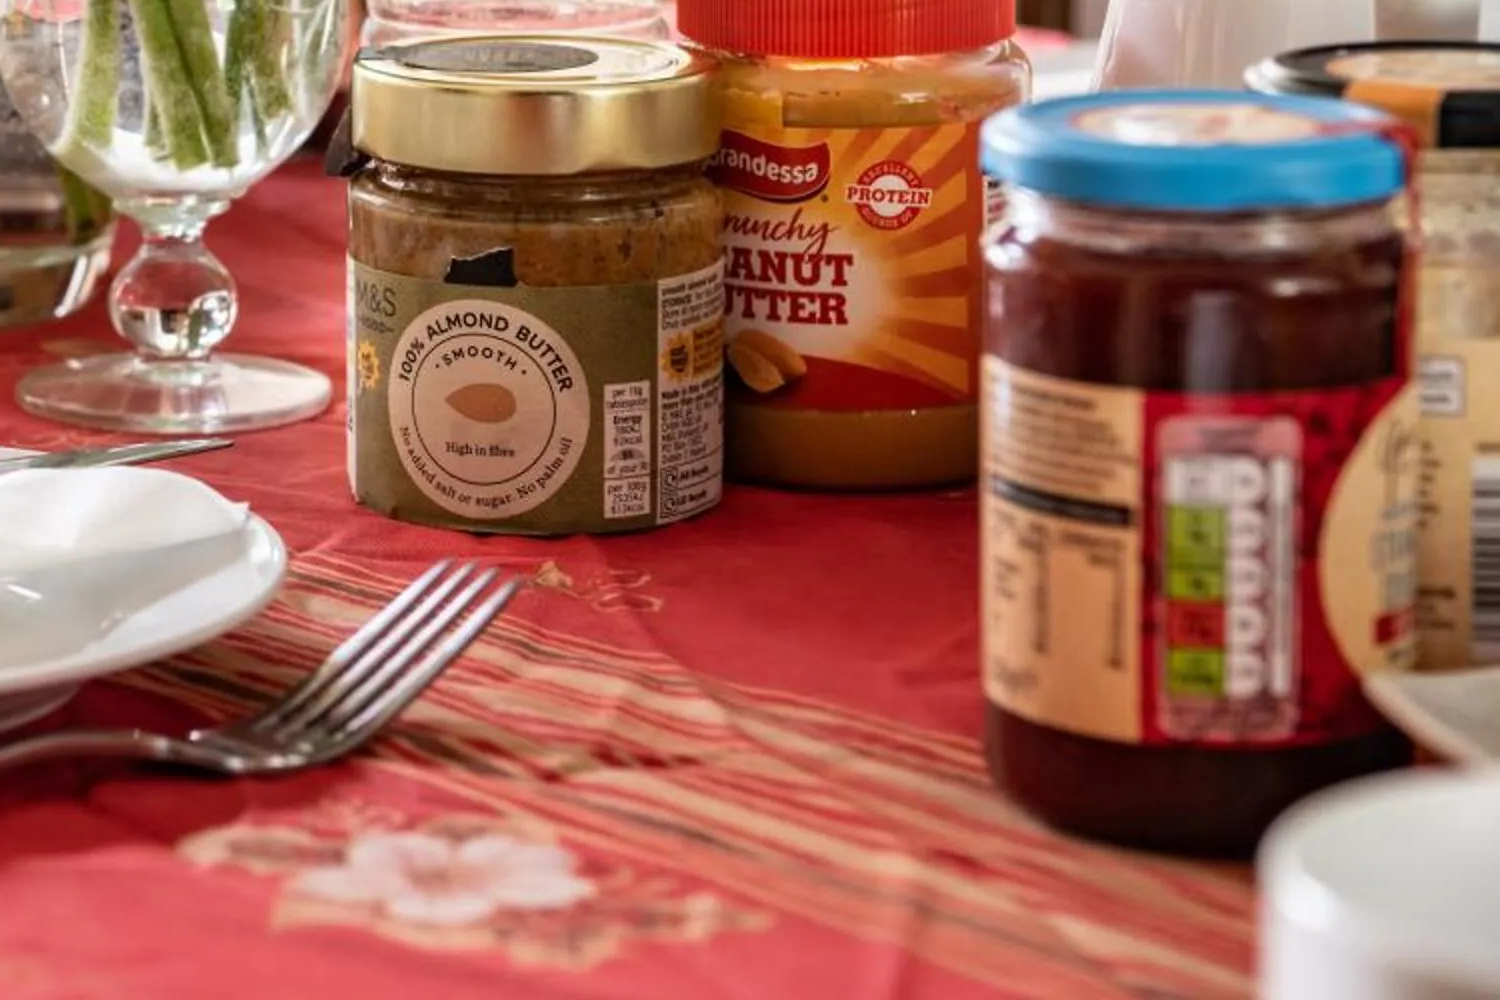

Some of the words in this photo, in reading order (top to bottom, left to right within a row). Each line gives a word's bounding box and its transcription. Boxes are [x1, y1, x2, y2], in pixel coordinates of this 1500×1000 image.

[846, 186, 930, 205] PROTEIN
[723, 208, 838, 265] runchy
[723, 246, 853, 287] ANUT
[356, 278, 397, 318] M&S
[723, 282, 849, 325] TTER
[398, 337, 425, 383] 100%
[426, 311, 510, 342] ALMOND
[514, 324, 573, 393] BUTTER
[442, 345, 518, 371] SMOOTH
[407, 449, 436, 480] added
[435, 481, 456, 499] salt
[515, 481, 538, 499] No
[536, 456, 564, 490] palm
[560, 436, 573, 456] oil
[445, 441, 473, 457] High
[475, 443, 487, 457] in
[489, 443, 515, 457] fibre
